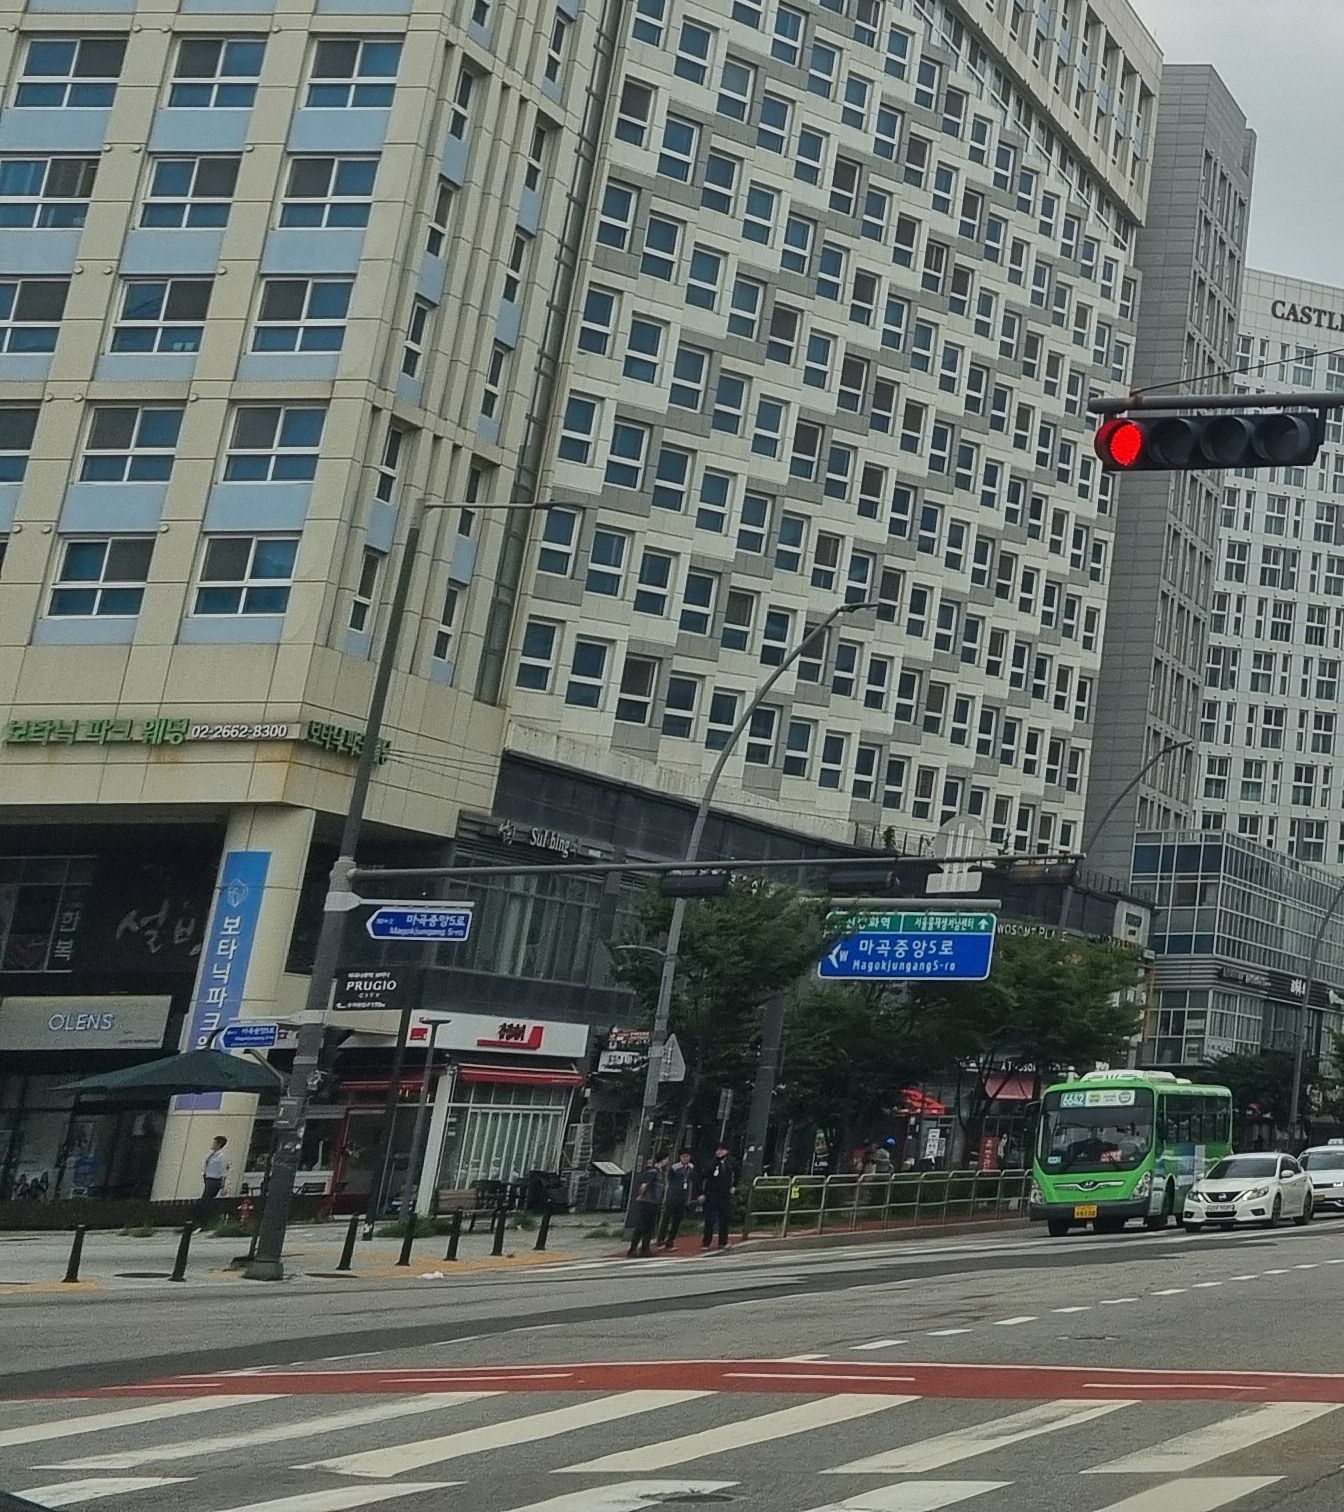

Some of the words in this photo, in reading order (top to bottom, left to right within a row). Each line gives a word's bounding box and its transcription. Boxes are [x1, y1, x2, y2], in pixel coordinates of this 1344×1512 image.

[191, 724, 288, 738] 02-2662-8300
[839, 950, 849, 962] W
[858, 939, 955, 959] 마곡중앙5로
[852, 959, 956, 974] Magokjungang5-ro
[346, 980, 397, 991] PRUGIO
[47, 1012, 116, 1033] OLENS
